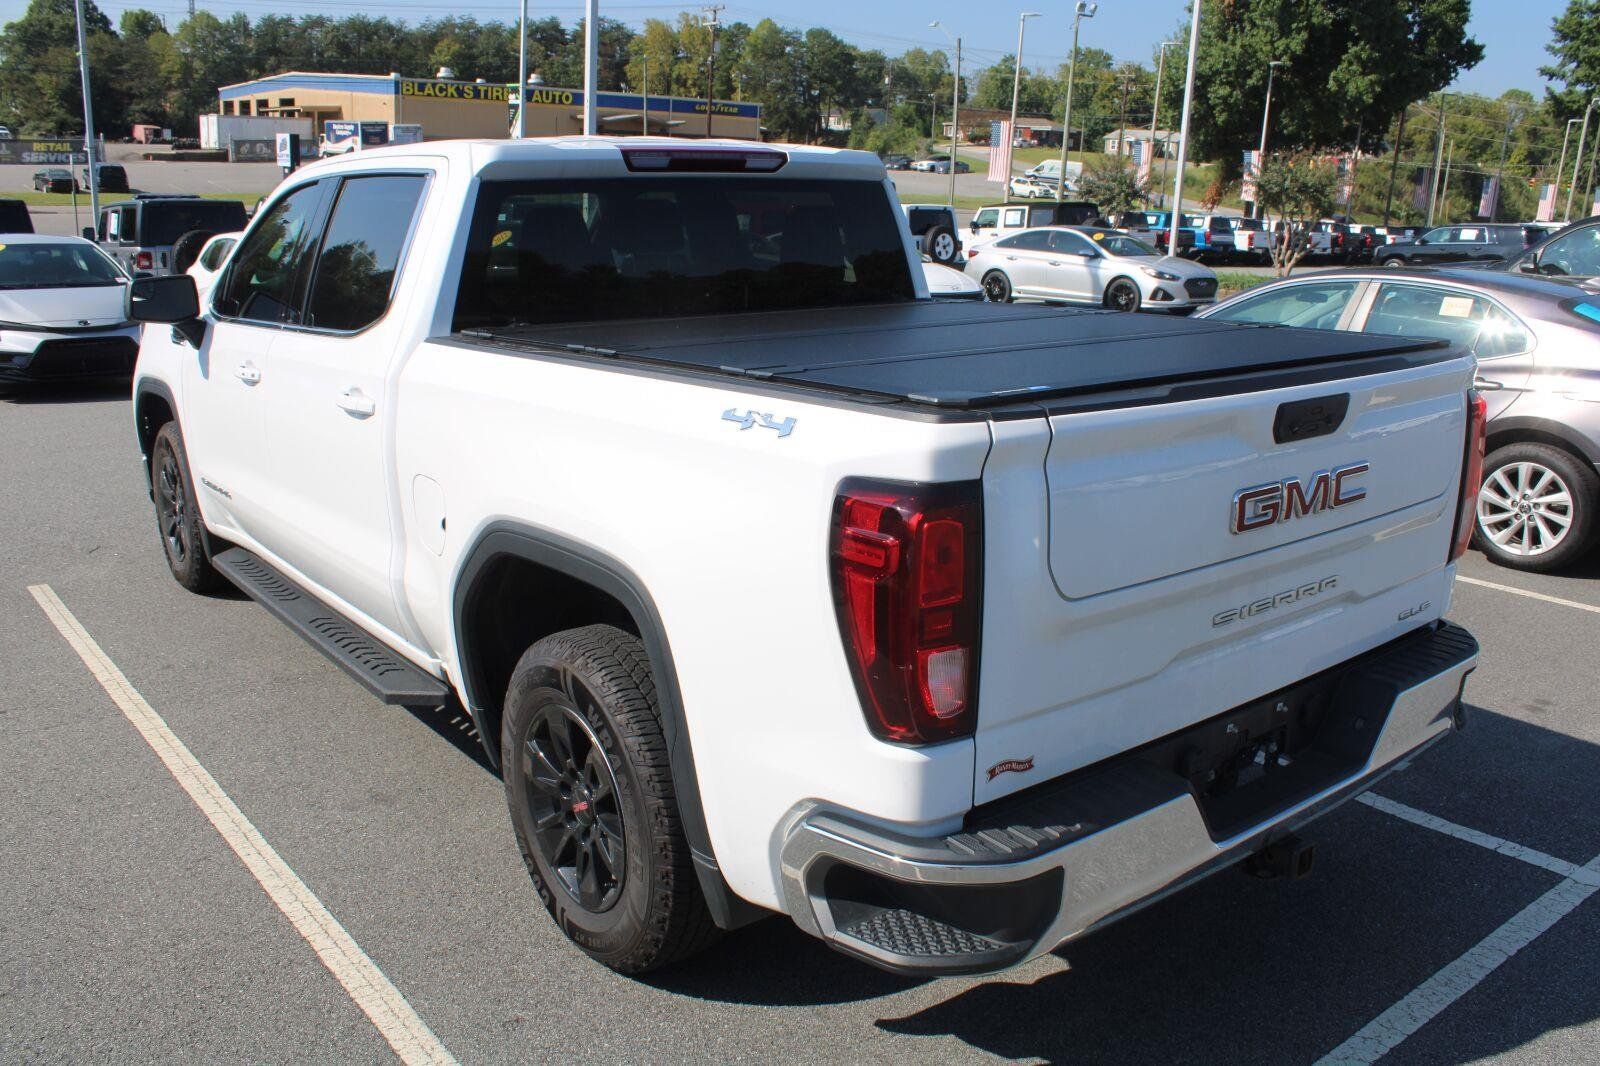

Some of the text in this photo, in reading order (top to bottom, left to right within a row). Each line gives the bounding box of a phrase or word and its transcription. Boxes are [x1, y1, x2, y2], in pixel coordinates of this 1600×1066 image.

[401, 81, 474, 99] BLACK'S
[532, 90, 573, 105] AUTO
[21, 152, 86, 163] SERVICES
[33, 142, 73, 152] RETAIL
[1229, 460, 1370, 535] GMC
[1212, 574, 1339, 628] SIERRA
